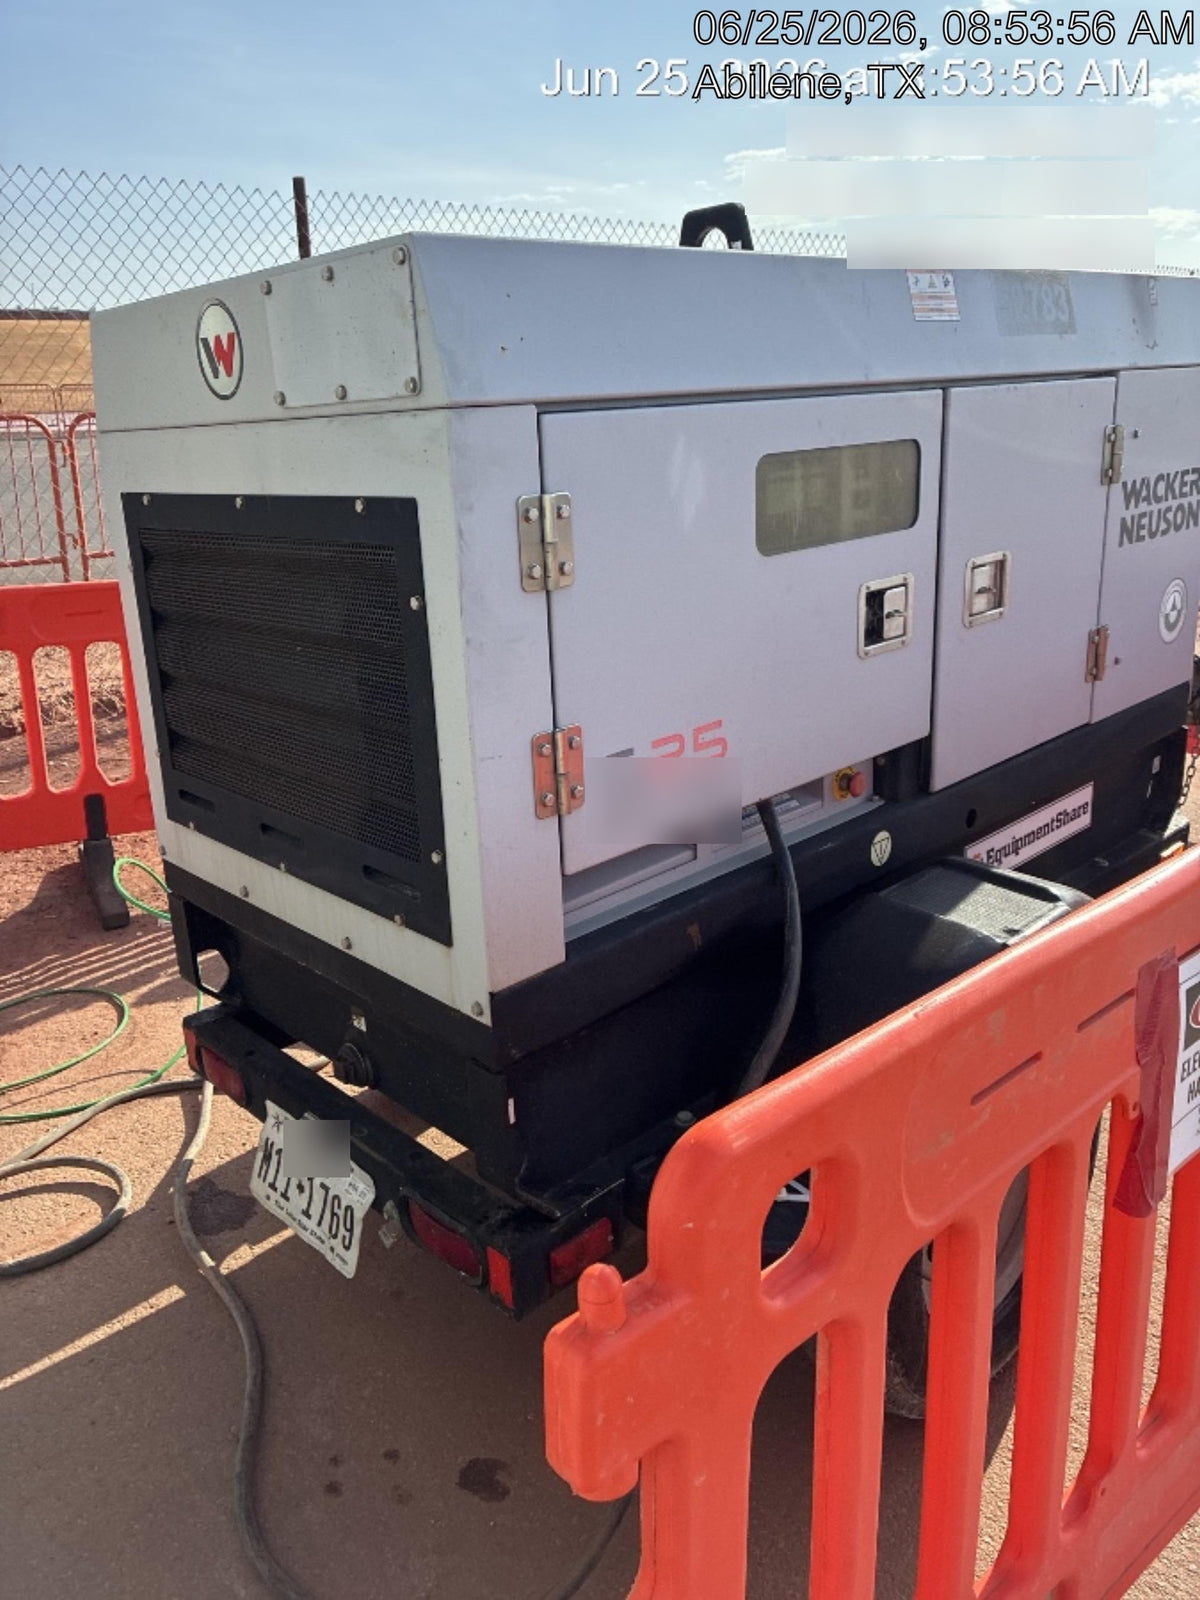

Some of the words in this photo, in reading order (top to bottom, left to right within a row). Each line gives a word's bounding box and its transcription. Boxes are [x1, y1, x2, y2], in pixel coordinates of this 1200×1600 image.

[1121, 467, 1200, 511] WACKER
[1118, 499, 1200, 548] NEUSON
[986, 801, 1090, 865] EquipmentShare
